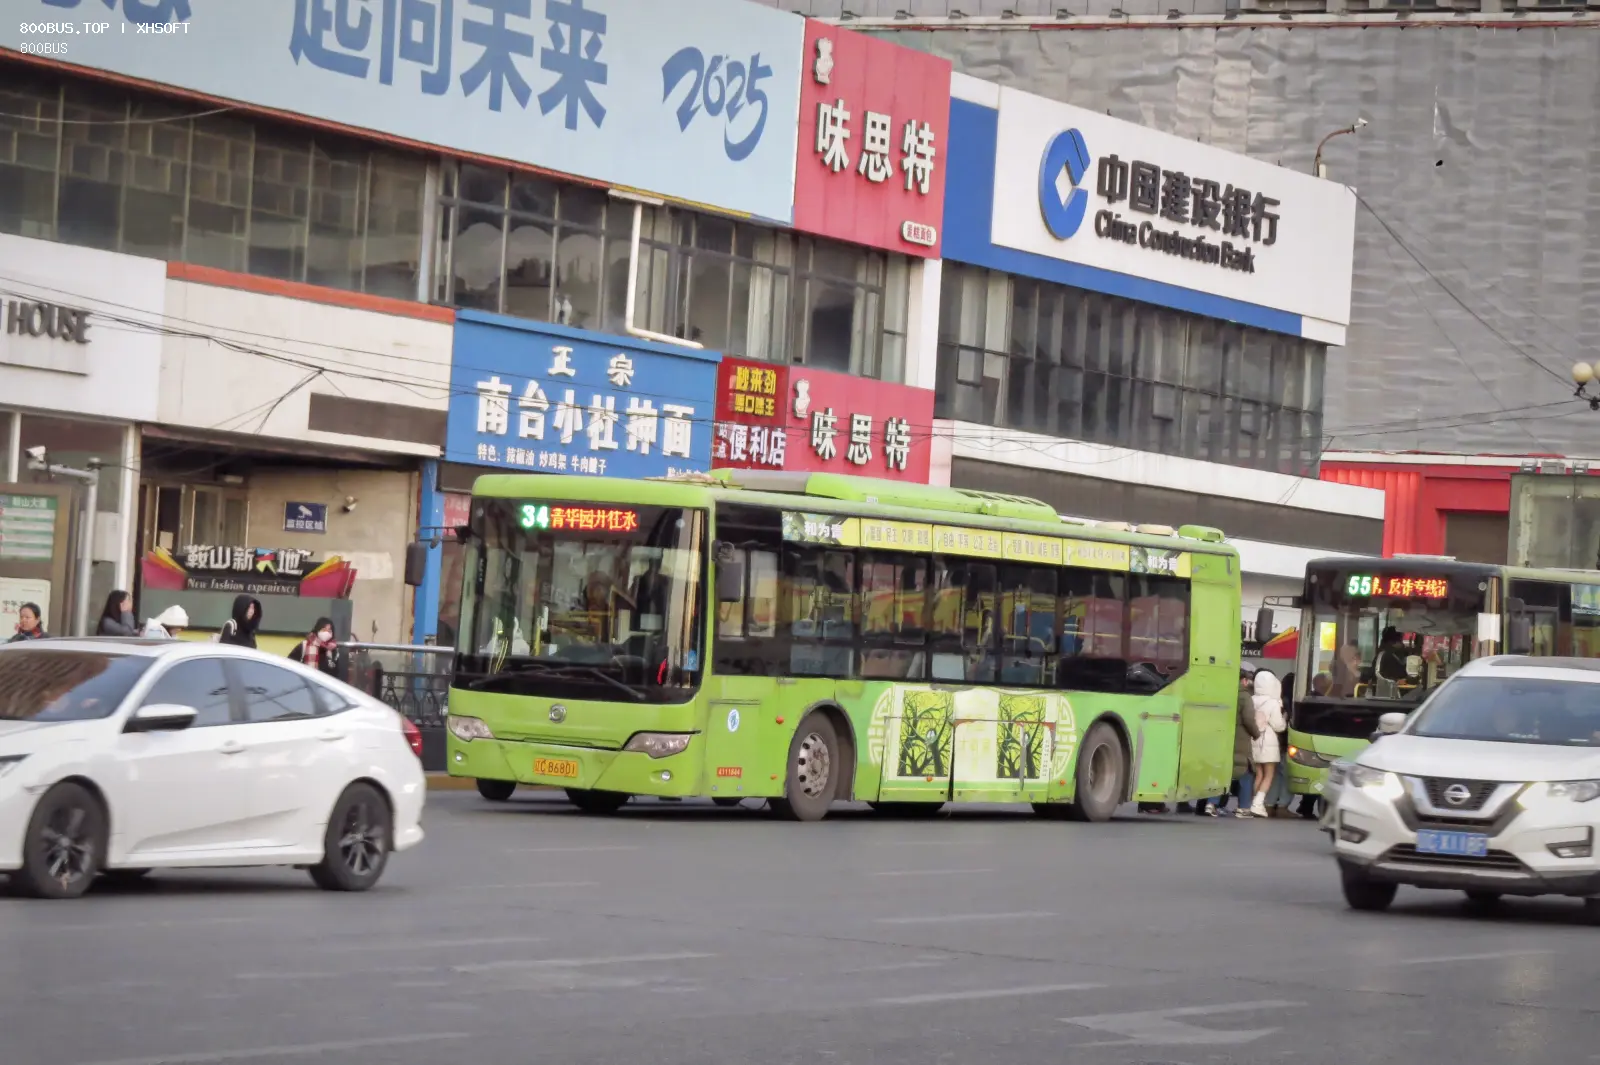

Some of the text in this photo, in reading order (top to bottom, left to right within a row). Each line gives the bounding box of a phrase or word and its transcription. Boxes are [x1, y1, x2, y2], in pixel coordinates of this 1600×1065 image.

[661, 46, 773, 161] 2025
[815, 98, 936, 195] 味思特
[1096, 153, 1281, 246] 中国建设银行
[1094, 209, 1255, 274] China Construction Bank
[7, 300, 92, 344] HOUSE
[729, 423, 787, 466] 便利店
[811, 406, 912, 471] 味思特
[522, 504, 549, 528] 34
[1348, 576, 1371, 595] 55
